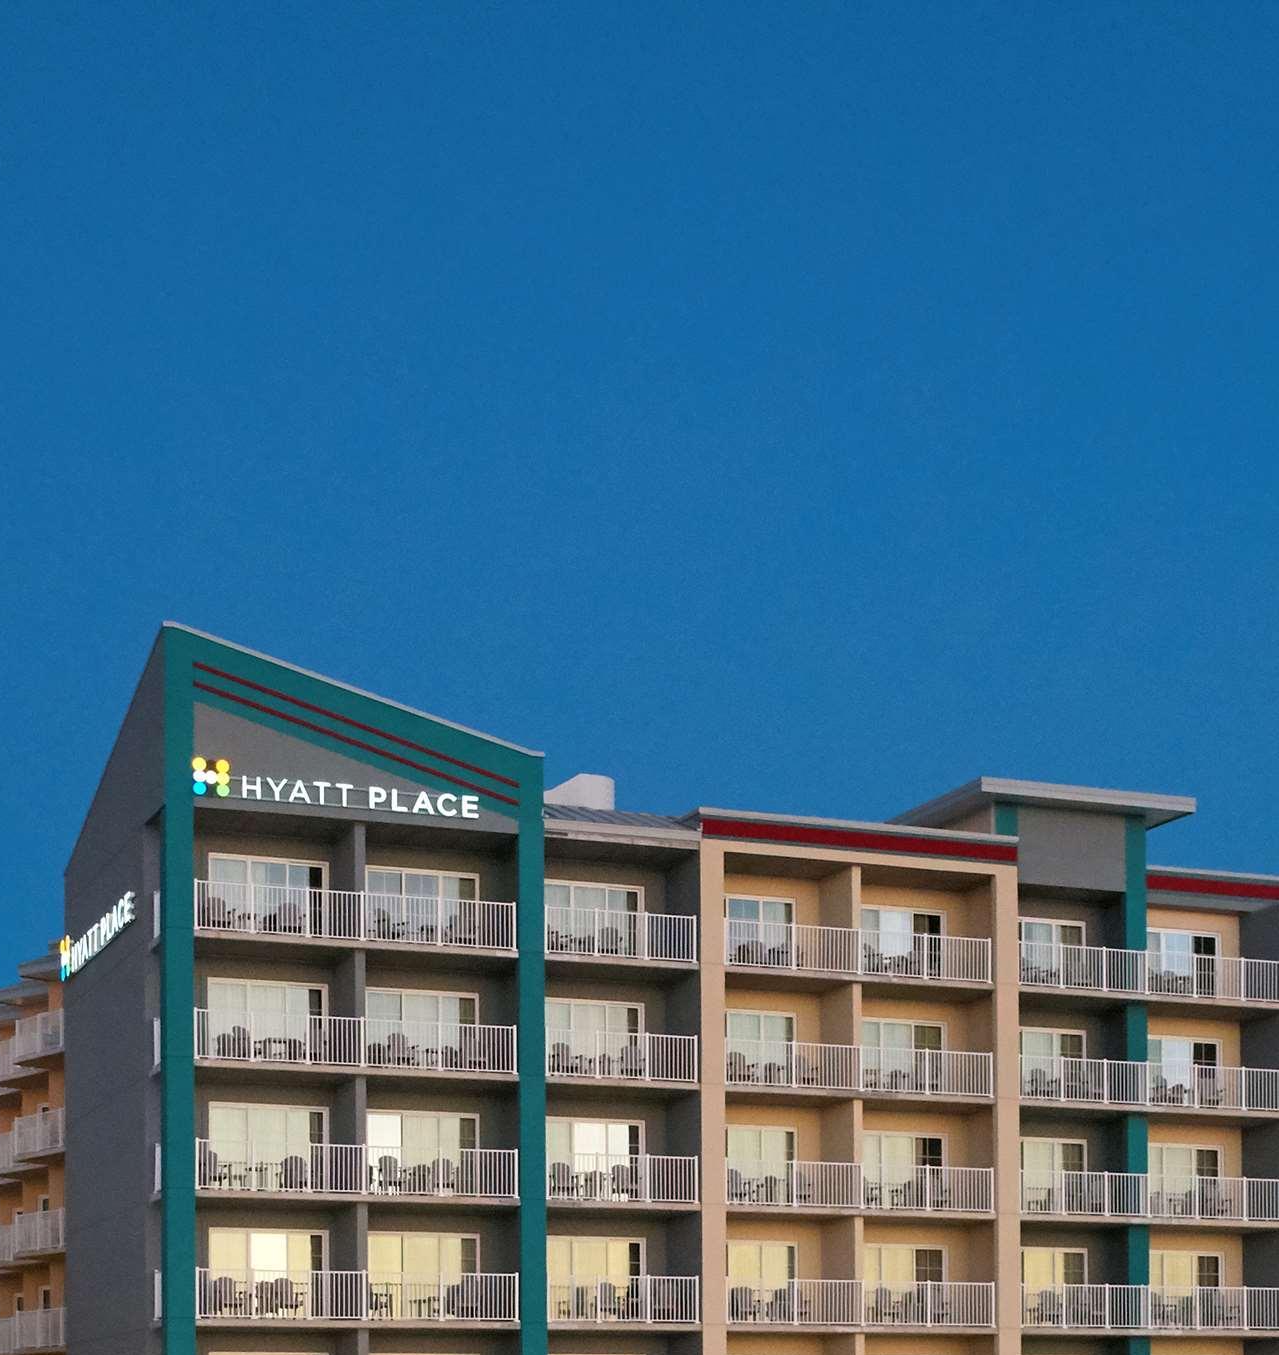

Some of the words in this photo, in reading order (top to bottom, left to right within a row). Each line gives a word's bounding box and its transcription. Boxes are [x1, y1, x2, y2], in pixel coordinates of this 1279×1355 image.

[241, 775, 354, 808] HYATT
[368, 786, 480, 819] PLACE
[71, 923, 100, 973] HYATT
[100, 891, 136, 946] PLACE
